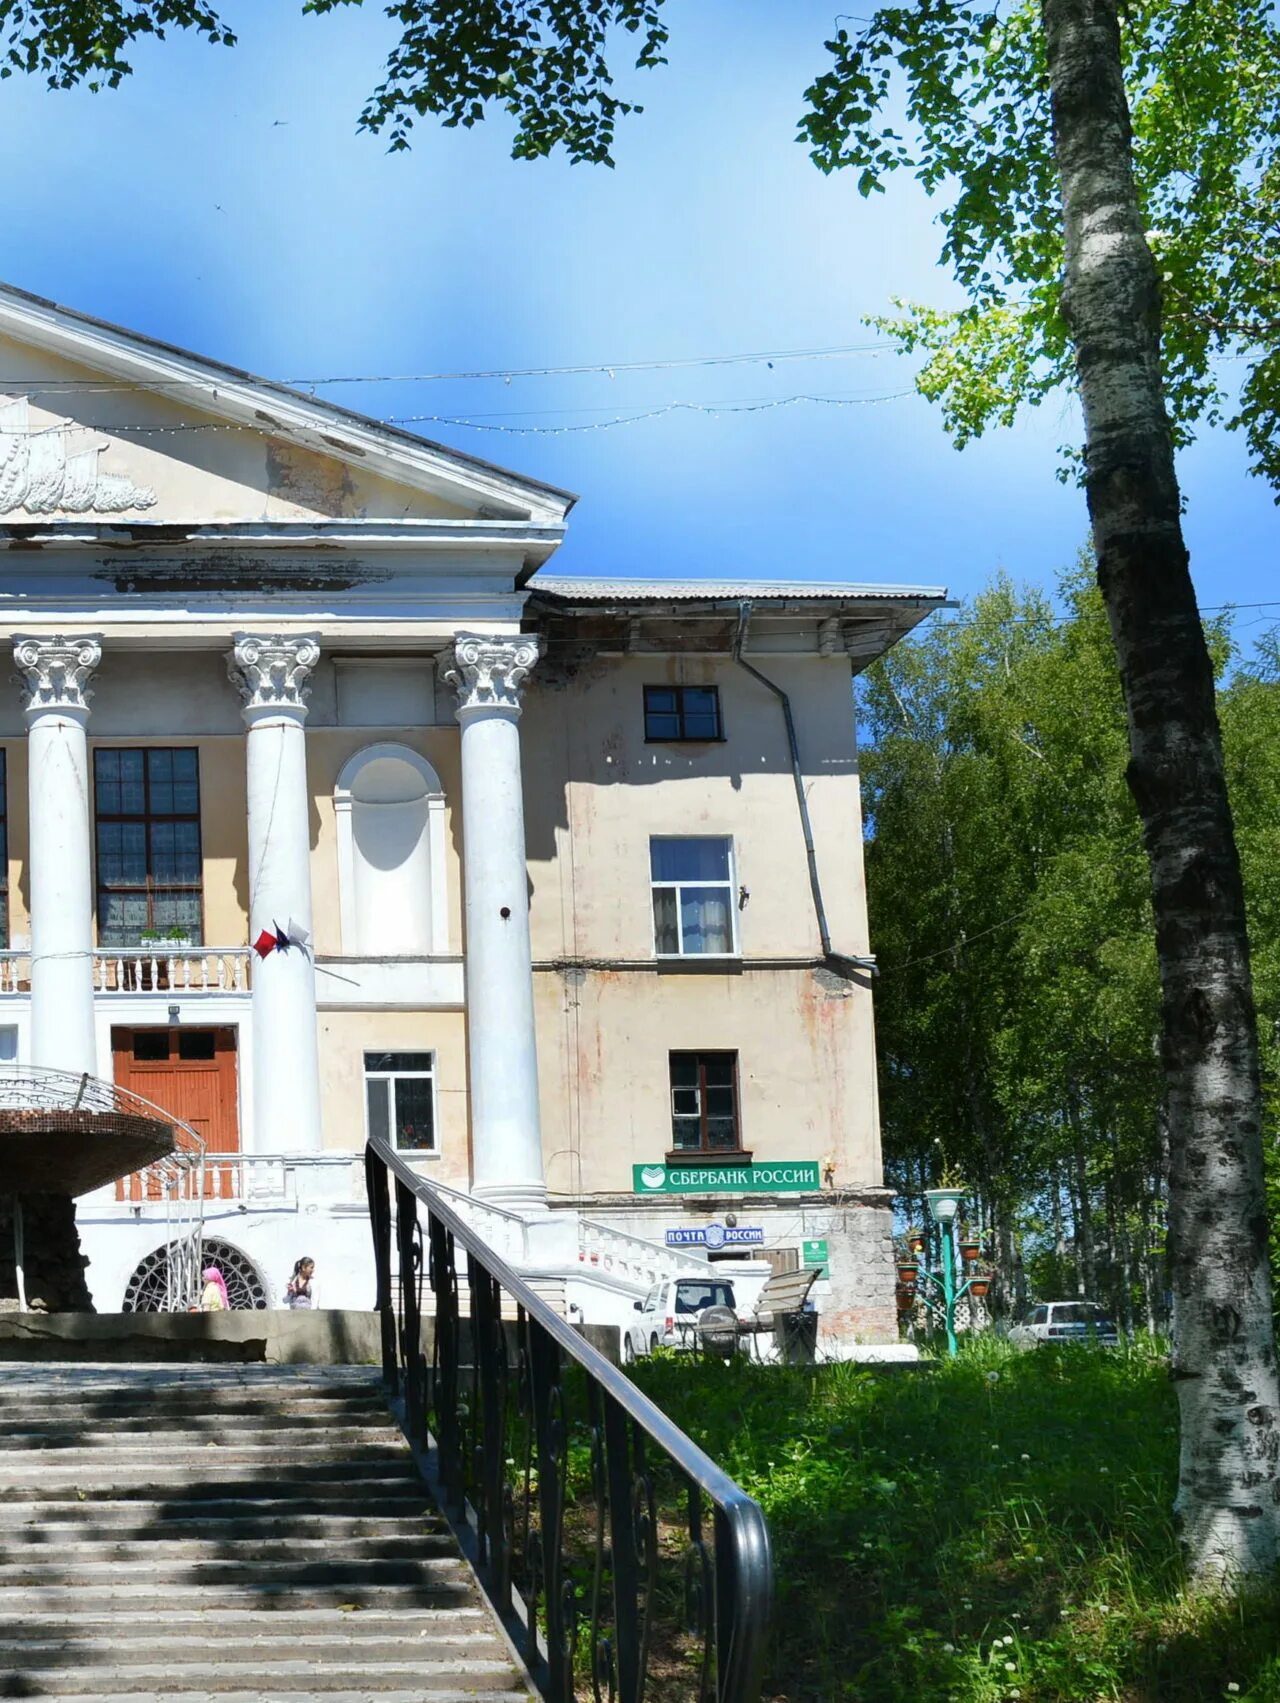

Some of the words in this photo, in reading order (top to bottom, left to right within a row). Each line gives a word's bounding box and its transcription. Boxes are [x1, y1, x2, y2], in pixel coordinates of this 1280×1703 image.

[670, 1170, 748, 1185] СБЕРБАНК
[753, 1169, 815, 1184] РОССИИ
[668, 1231, 705, 1241] ПОЧТА
[725, 1230, 762, 1240] РОССИИ
